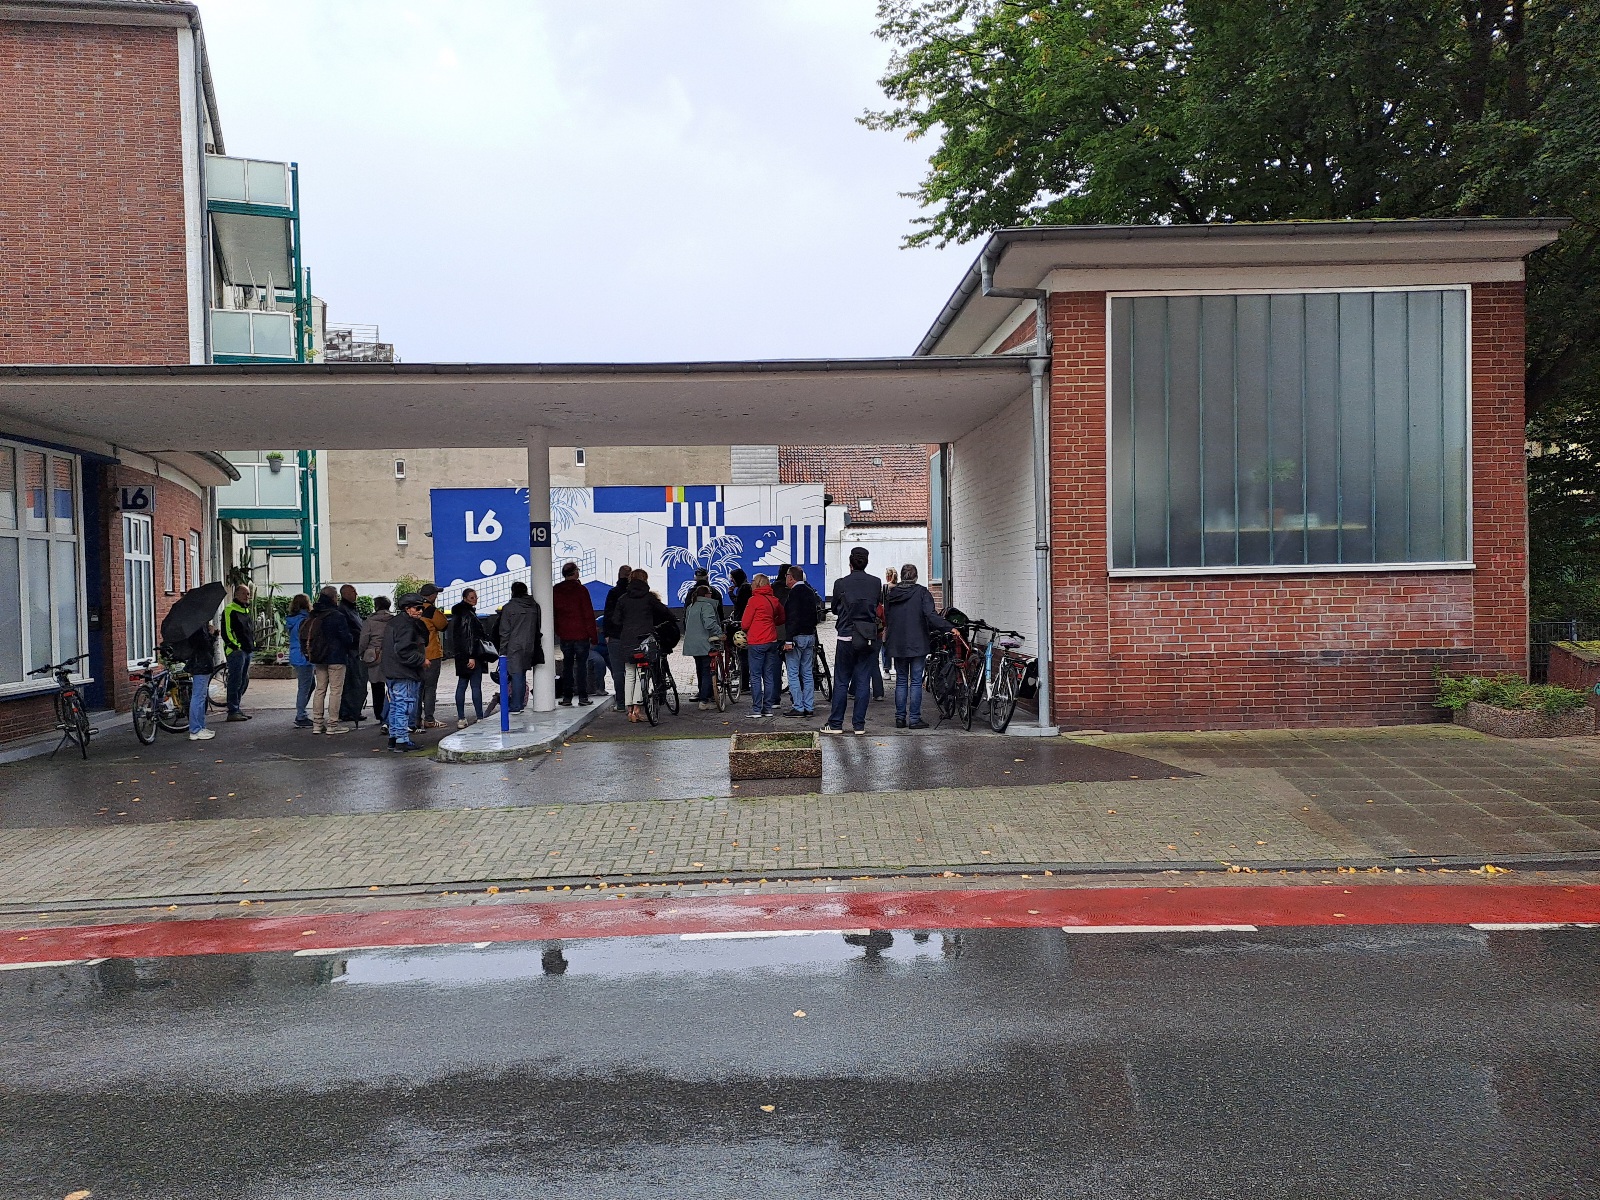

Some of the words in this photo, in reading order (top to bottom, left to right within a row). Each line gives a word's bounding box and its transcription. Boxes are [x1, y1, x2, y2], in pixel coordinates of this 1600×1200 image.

[122, 487, 149, 510] L6
[465, 509, 503, 542] L6
[531, 527, 547, 541] 19
